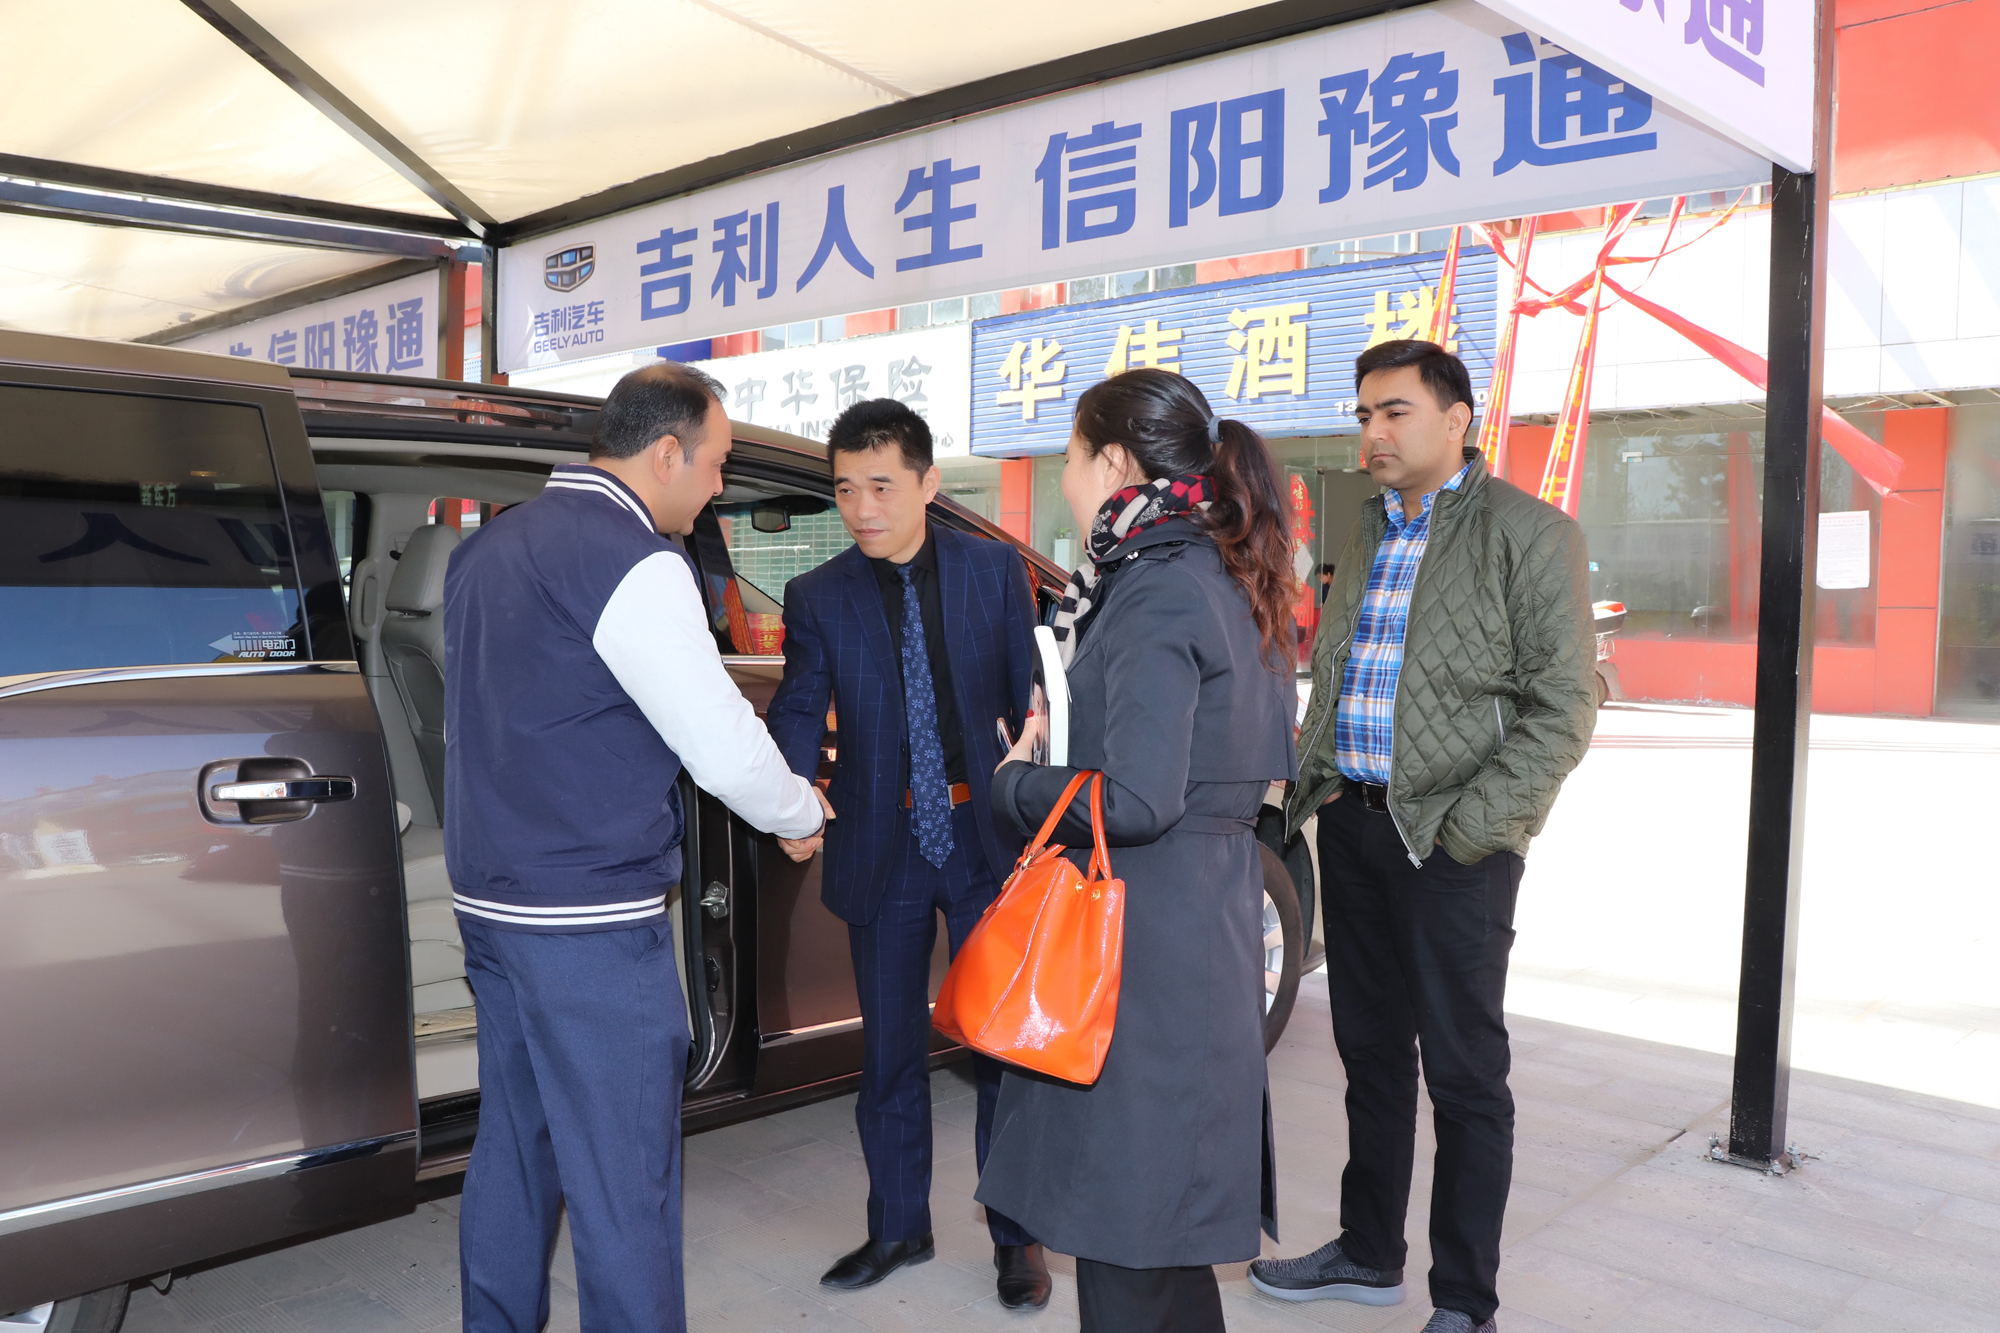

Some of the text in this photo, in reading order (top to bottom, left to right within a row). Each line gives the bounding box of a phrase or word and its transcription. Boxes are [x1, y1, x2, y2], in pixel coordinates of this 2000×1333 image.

[636, 32, 1658, 322] 吉利人生 信阳豫通
[267, 297, 424, 373] 信阳豫通
[533, 329, 604, 354] GEELY AUTO
[534, 300, 604, 337] 吉利汽车
[734, 355, 933, 423] 中华保险
[262, 639, 296, 649] 电动门
